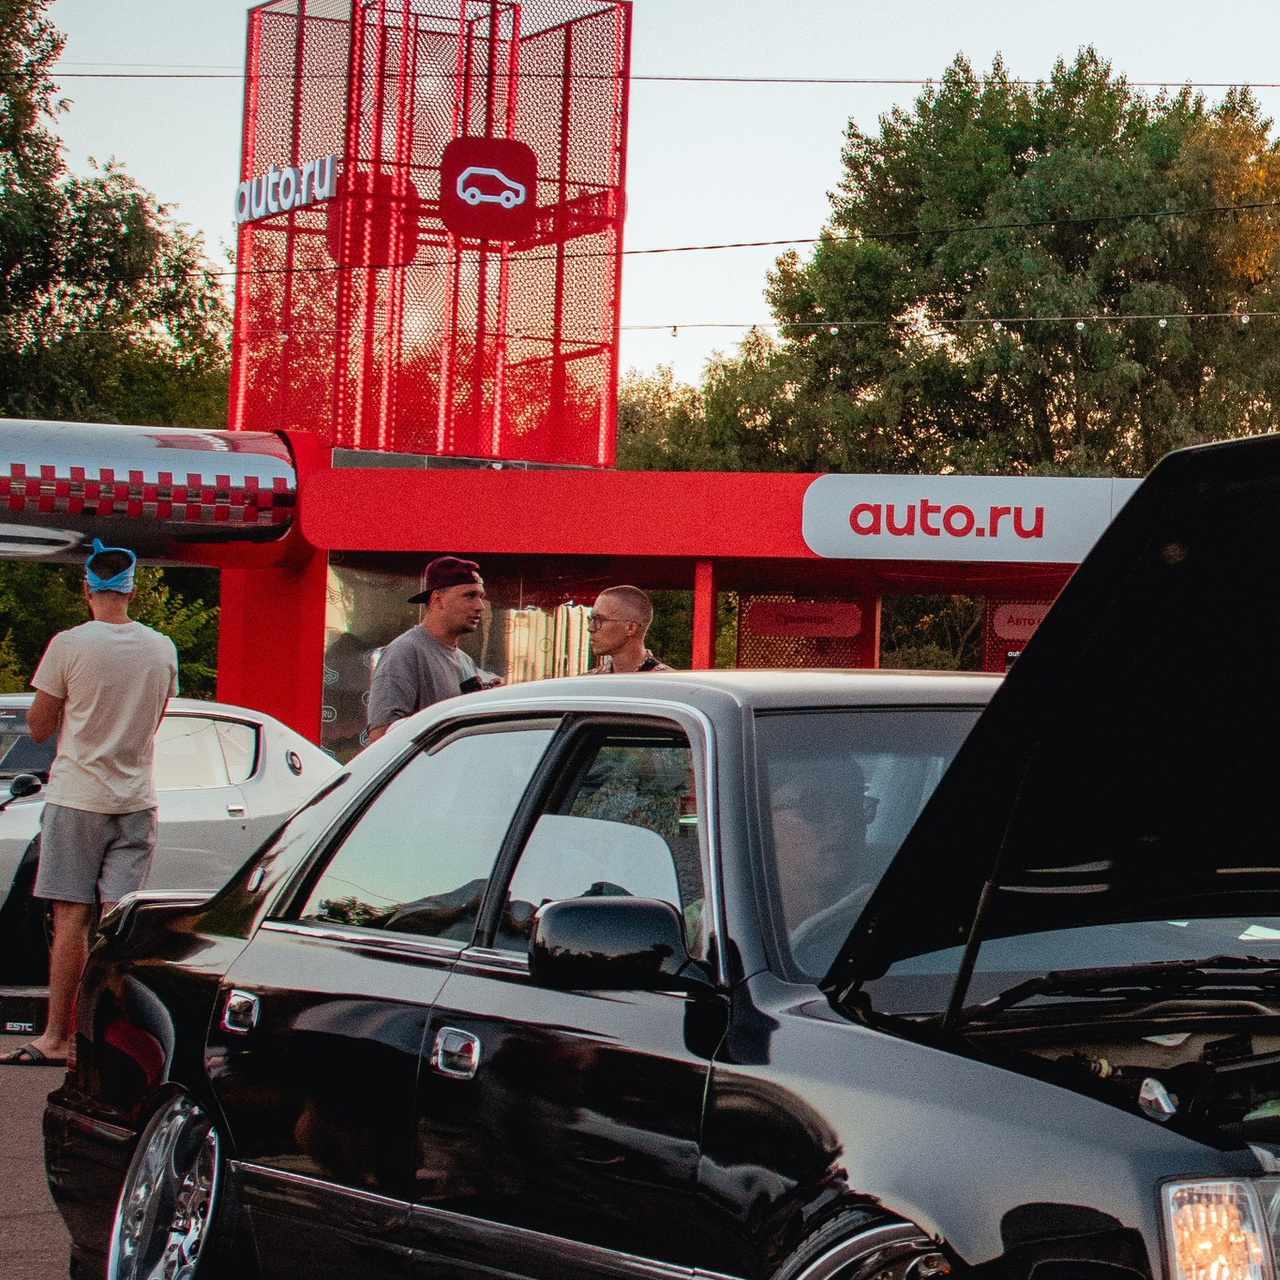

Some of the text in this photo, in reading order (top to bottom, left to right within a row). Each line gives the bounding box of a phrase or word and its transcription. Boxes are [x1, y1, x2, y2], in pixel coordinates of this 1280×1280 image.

[235, 155, 336, 224] auto.ru
[849, 498, 1044, 539] auto.ru
[5, 1022, 33, 1031] ESTC
